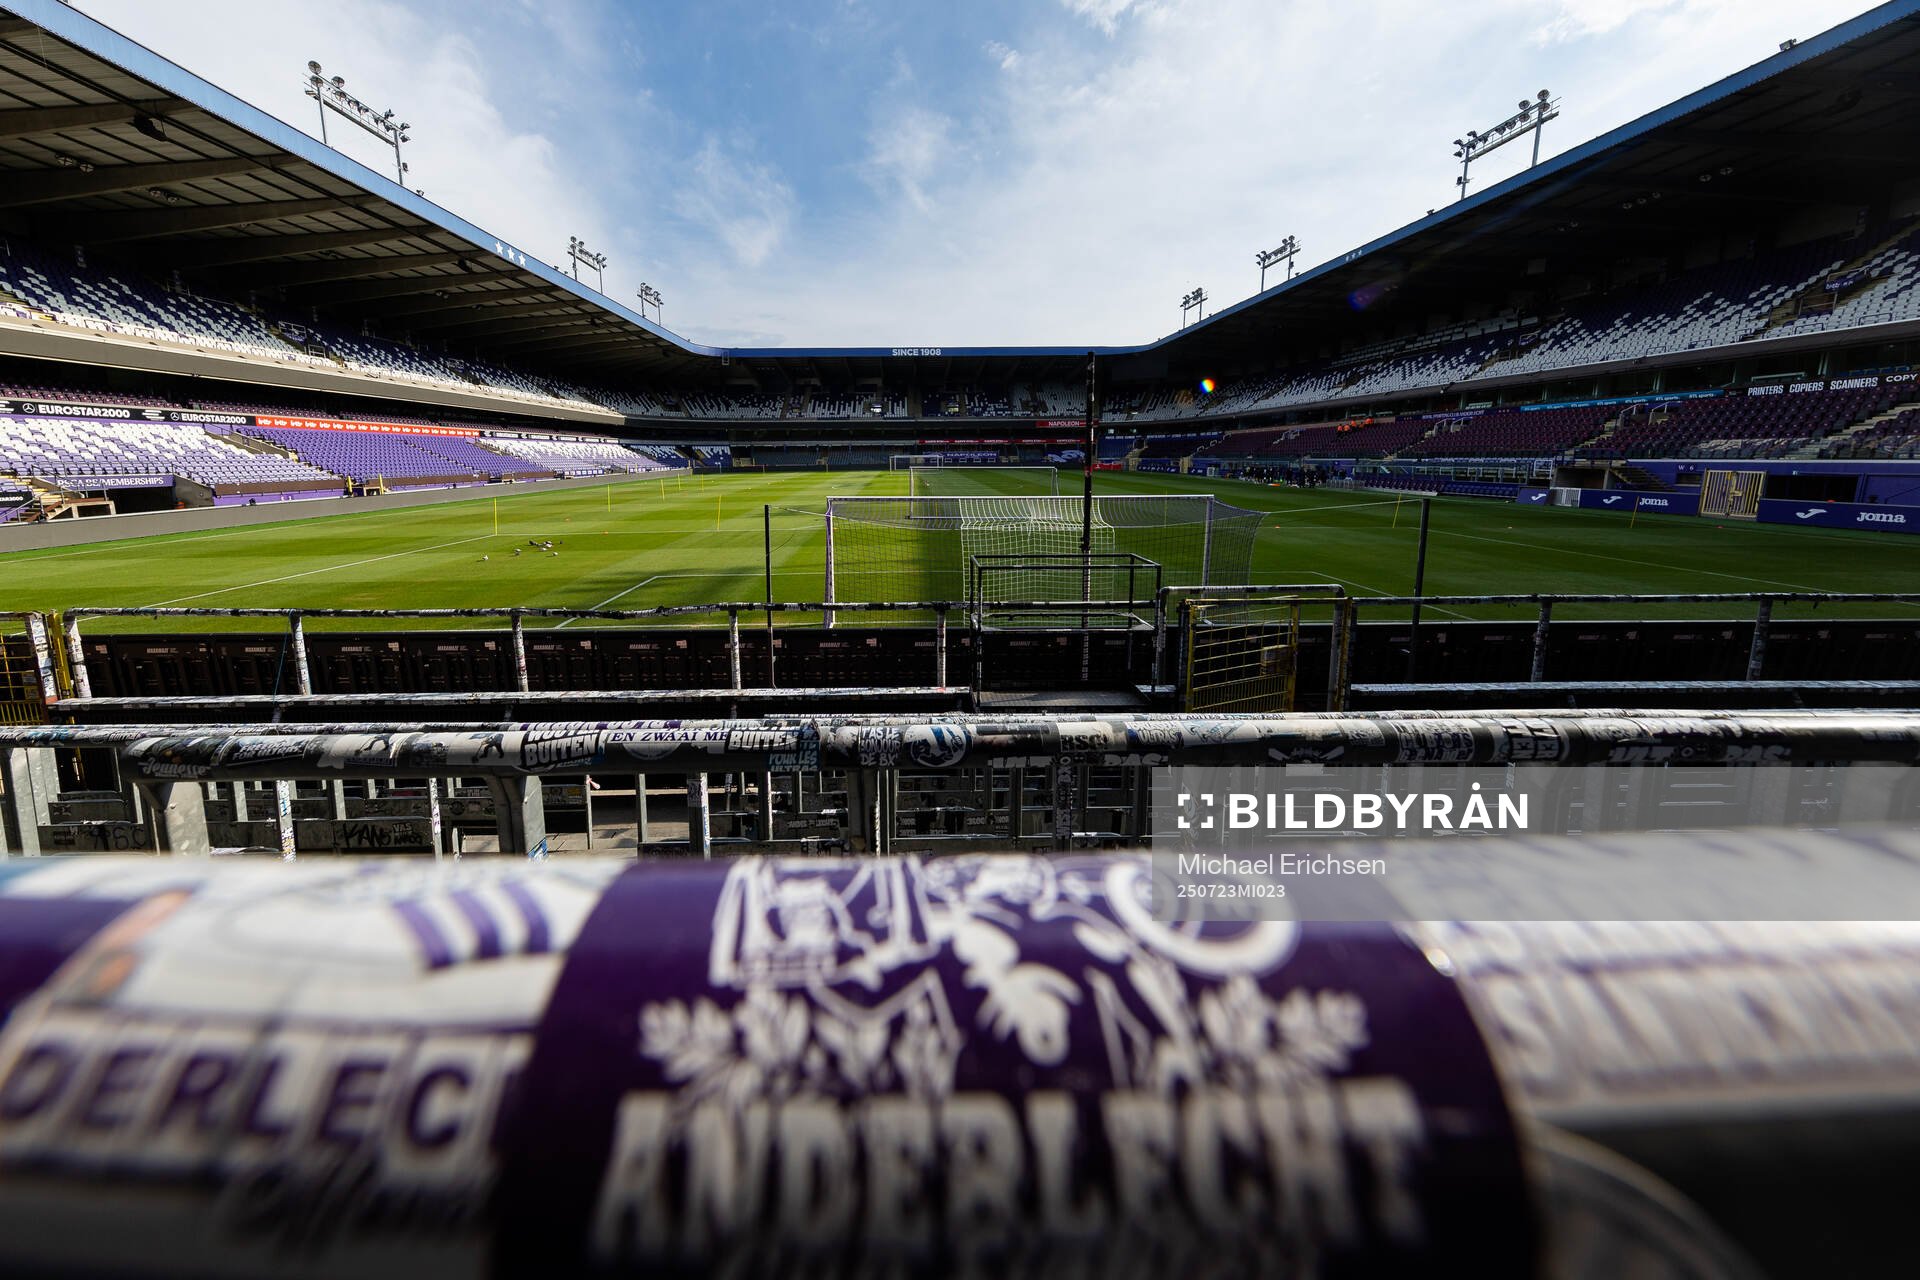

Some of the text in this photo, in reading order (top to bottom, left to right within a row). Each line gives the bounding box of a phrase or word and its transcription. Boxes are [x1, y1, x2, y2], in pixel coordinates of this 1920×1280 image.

[892, 348, 942, 356] SINCE 1908
[1885, 374, 1918, 383] COPY
[1748, 377, 1879, 396] PRINTERS COPIERS SCANNERS
[38, 404, 131, 419] EUROSTAR2000
[181, 412, 246, 424] EUROSTAR2000
[611, 732, 634, 741] EN
[641, 732, 697, 741] ZWAAI
[727, 730, 800, 751] BUITEN
[525, 733, 598, 767] BUITEN
[798, 750, 818, 765] LES
[138, 758, 210, 776] Jeunesse
[589, 1080, 1426, 1250] ANDERLECHT
